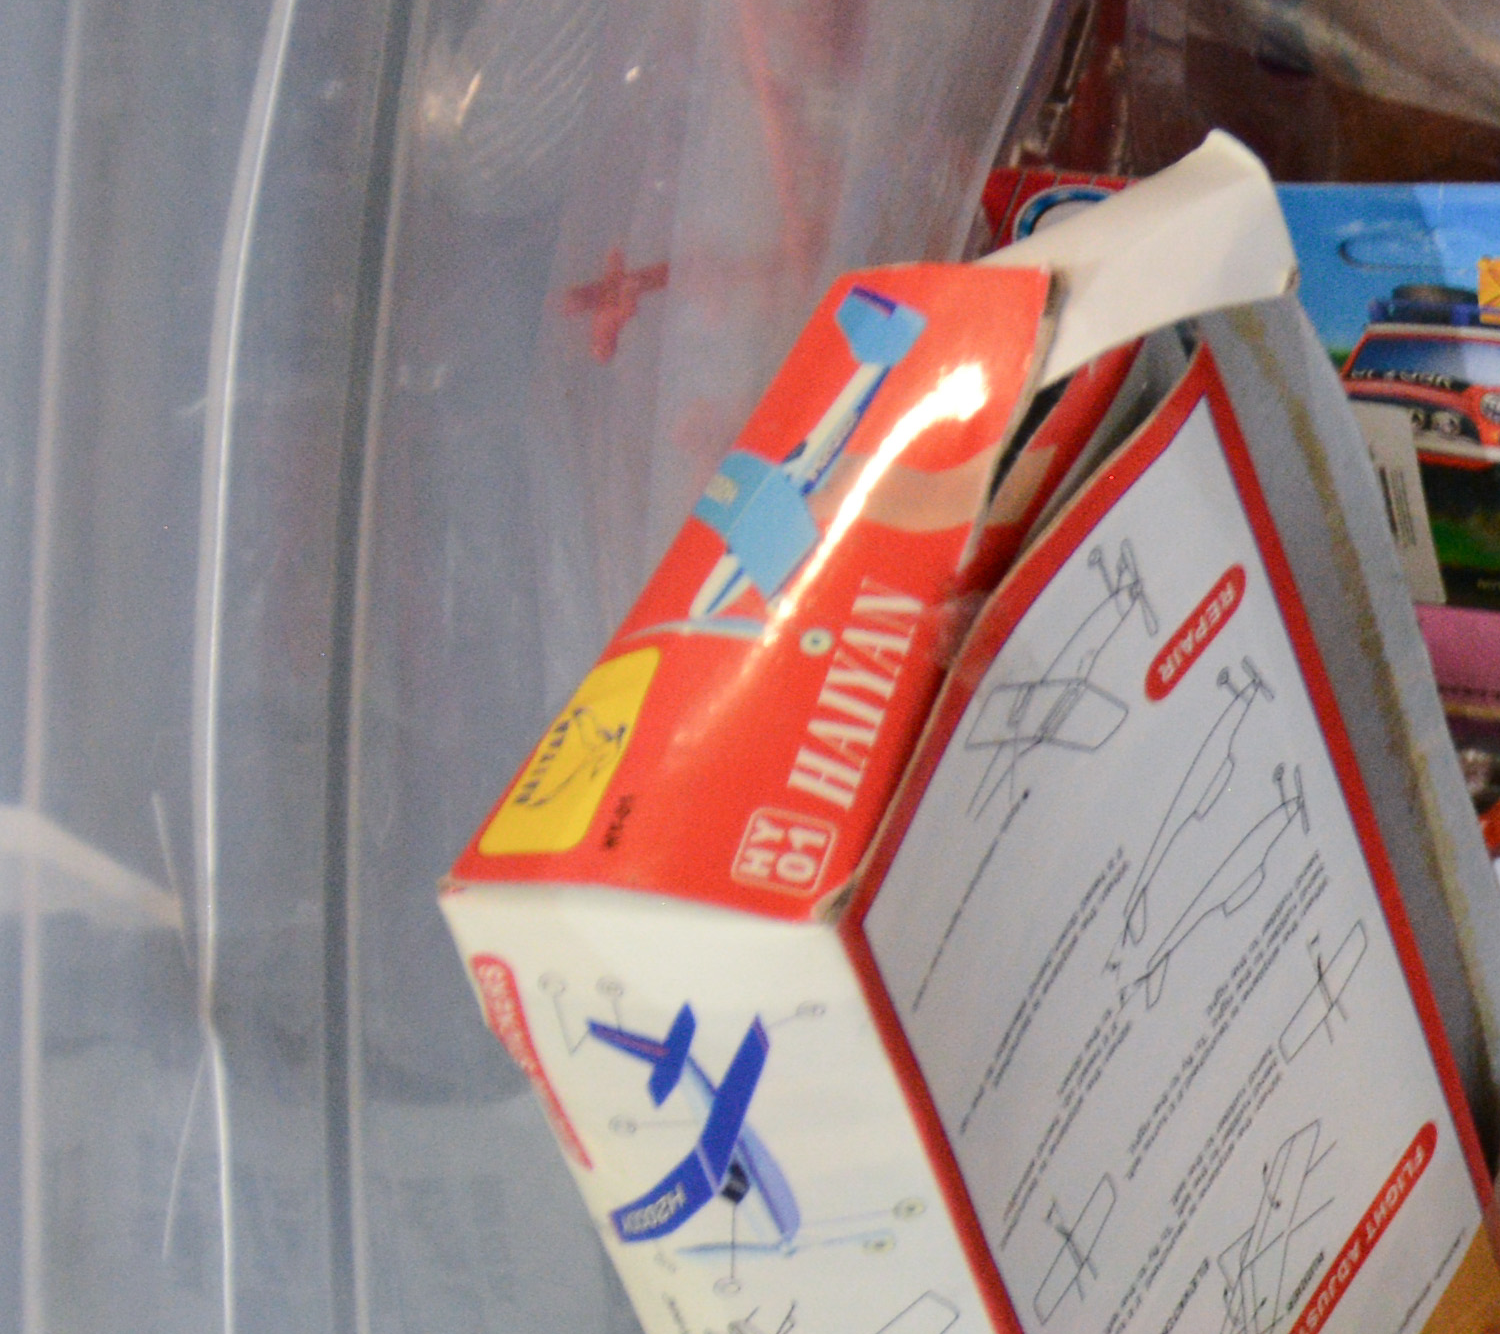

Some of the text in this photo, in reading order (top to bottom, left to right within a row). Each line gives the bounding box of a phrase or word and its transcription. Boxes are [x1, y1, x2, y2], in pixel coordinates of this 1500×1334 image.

[1150, 579, 1243, 685] REPAIR
[786, 575, 924, 811] HAIYAN
[738, 817, 776, 879] HY
[776, 820, 832, 883] 01
[1348, 1134, 1430, 1258] FLIGHT
